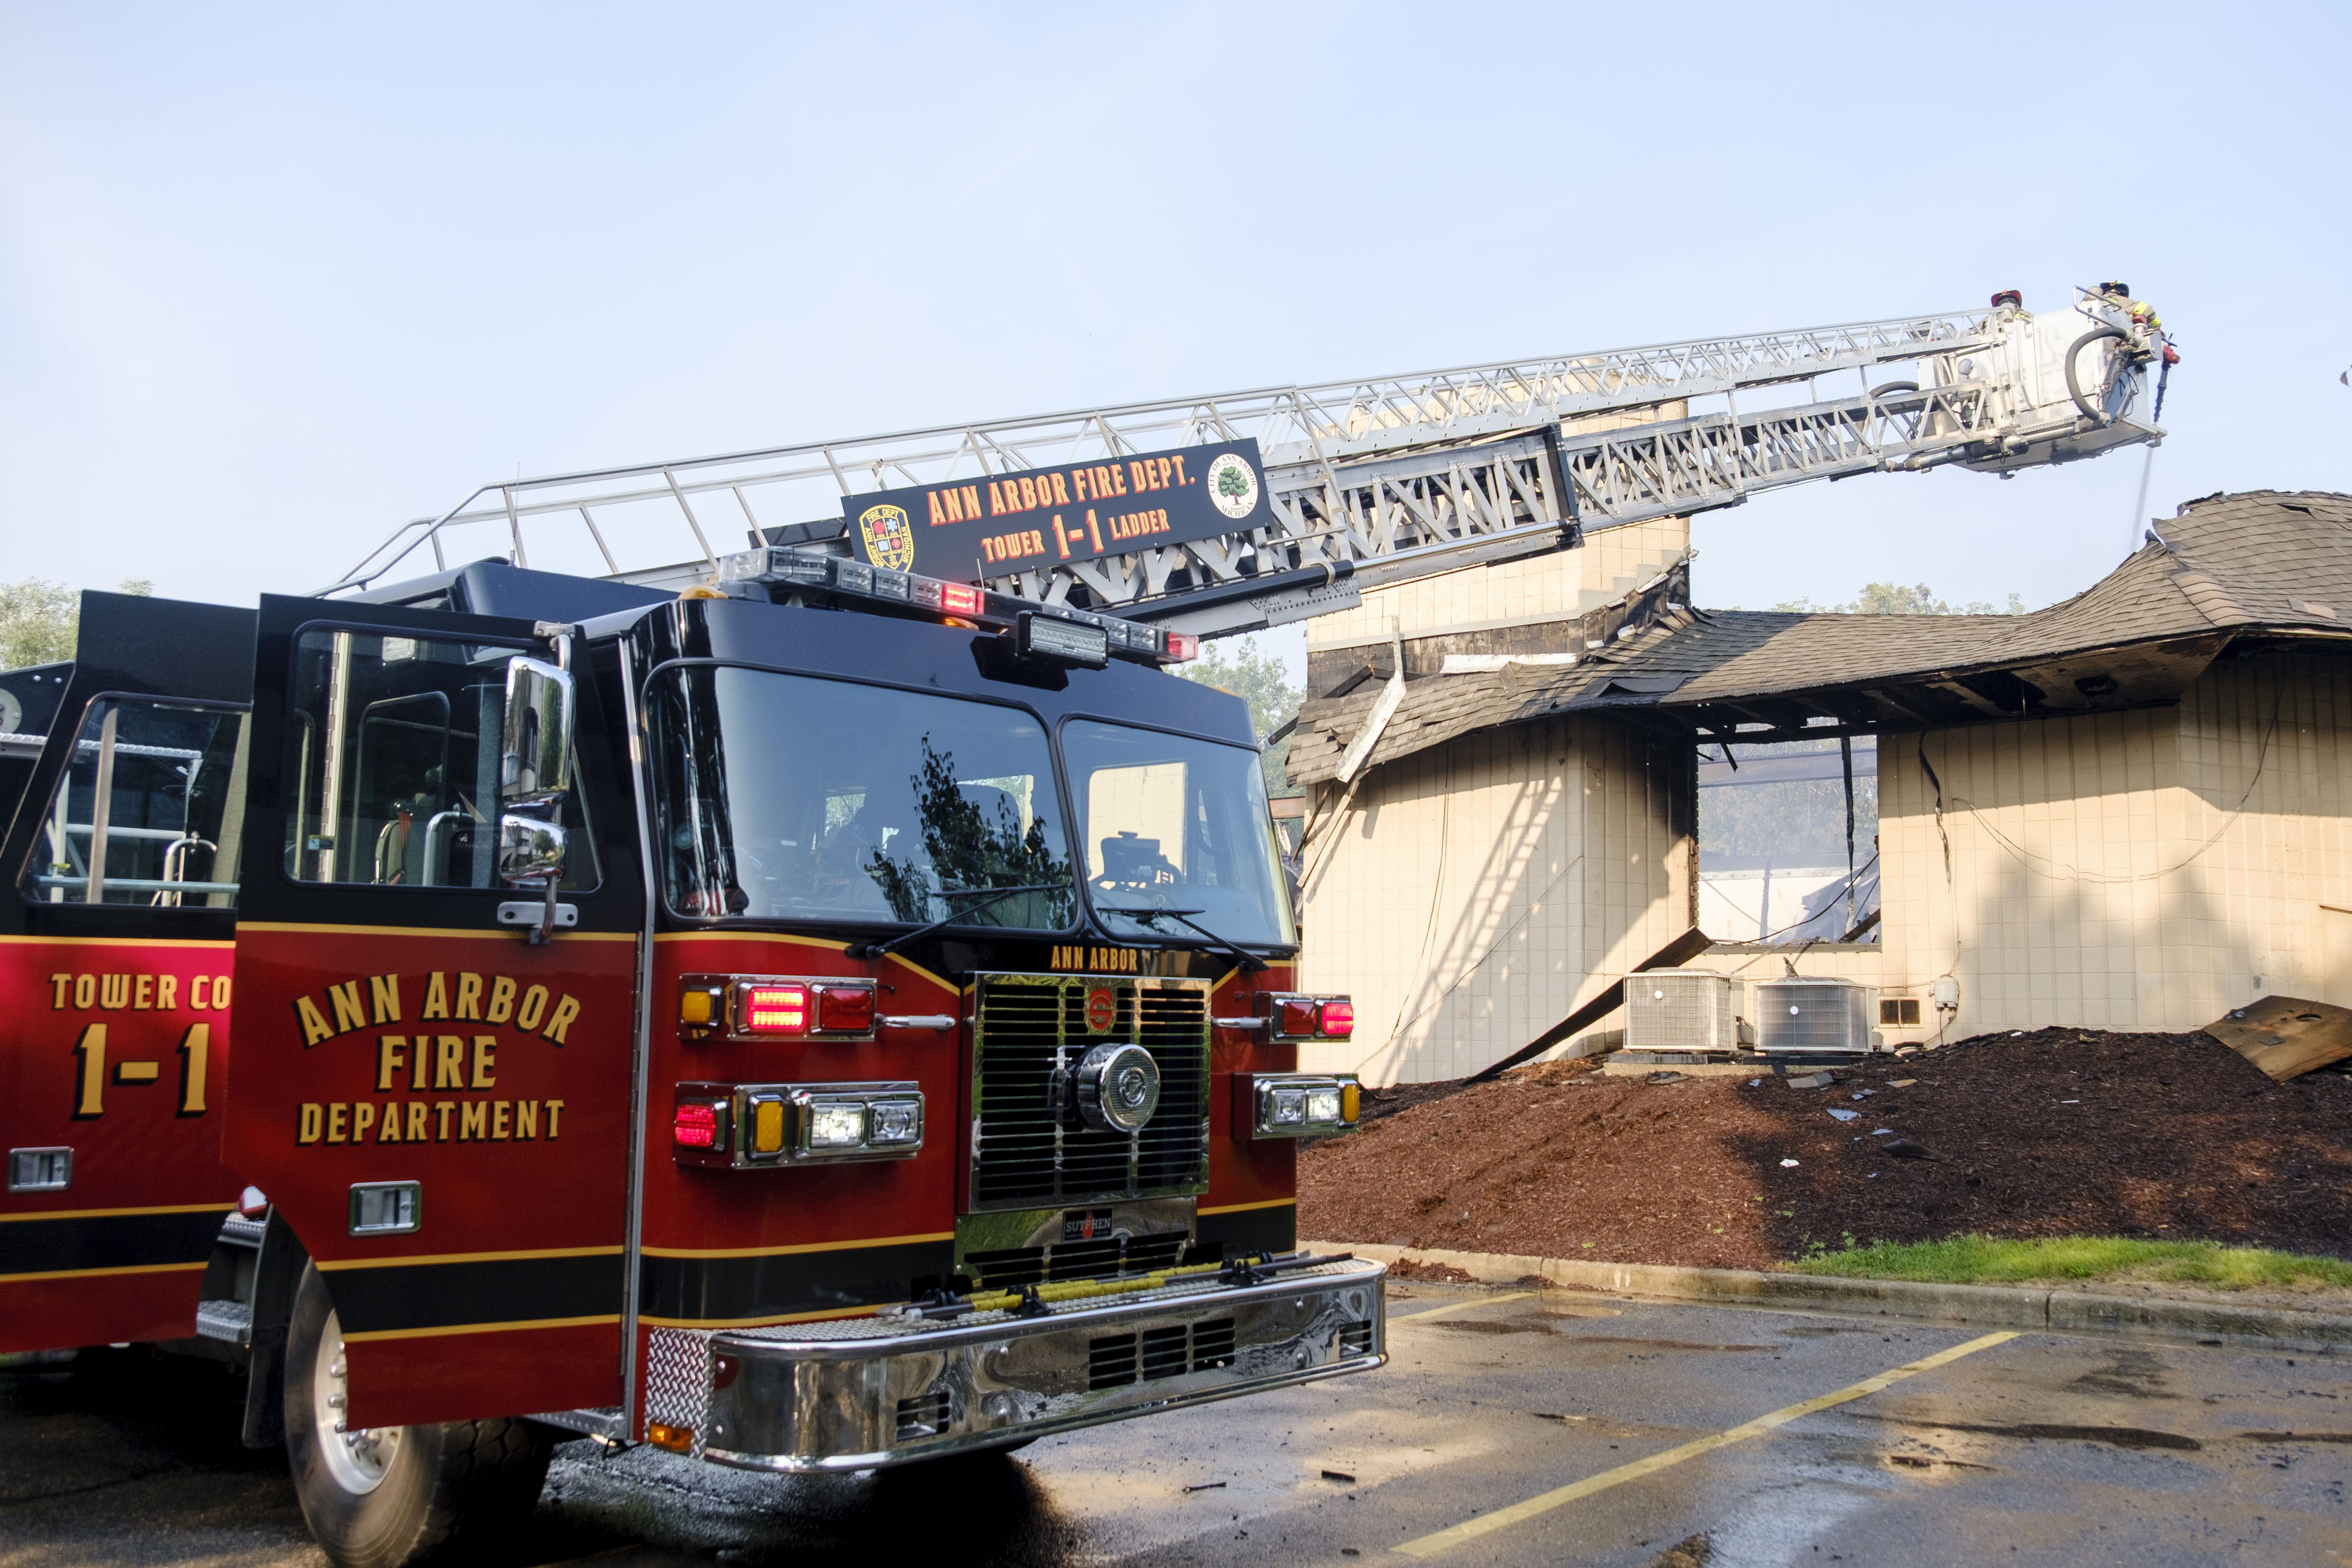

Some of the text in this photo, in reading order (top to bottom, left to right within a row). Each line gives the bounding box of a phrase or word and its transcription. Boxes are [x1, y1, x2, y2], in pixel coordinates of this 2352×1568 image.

[927, 455, 1195, 526] ANN ARBOR FIRE DEPT.
[1212, 461, 1220, 470] OF
[1240, 460, 1257, 486] ARBOR
[866, 508, 900, 522] FIRE DEPT
[1222, 502, 1254, 517] MICHIGAN
[865, 527, 874, 542] ANN
[901, 526, 911, 564] MICHIGAN
[981, 509, 1171, 564] TOWER 1-1 LADDER
[869, 544, 885, 568] ARBOR
[1050, 945, 1138, 972] ANN ARBOR
[50, 974, 232, 1011] TOWER CO
[292, 971, 581, 1050] ANN ARBOR
[72, 1023, 210, 1120] 1-1
[375, 1035, 497, 1092] FIRE
[296, 1099, 564, 1146] DEPARTMENT
[1066, 1218, 1111, 1232] SUTPHEN
